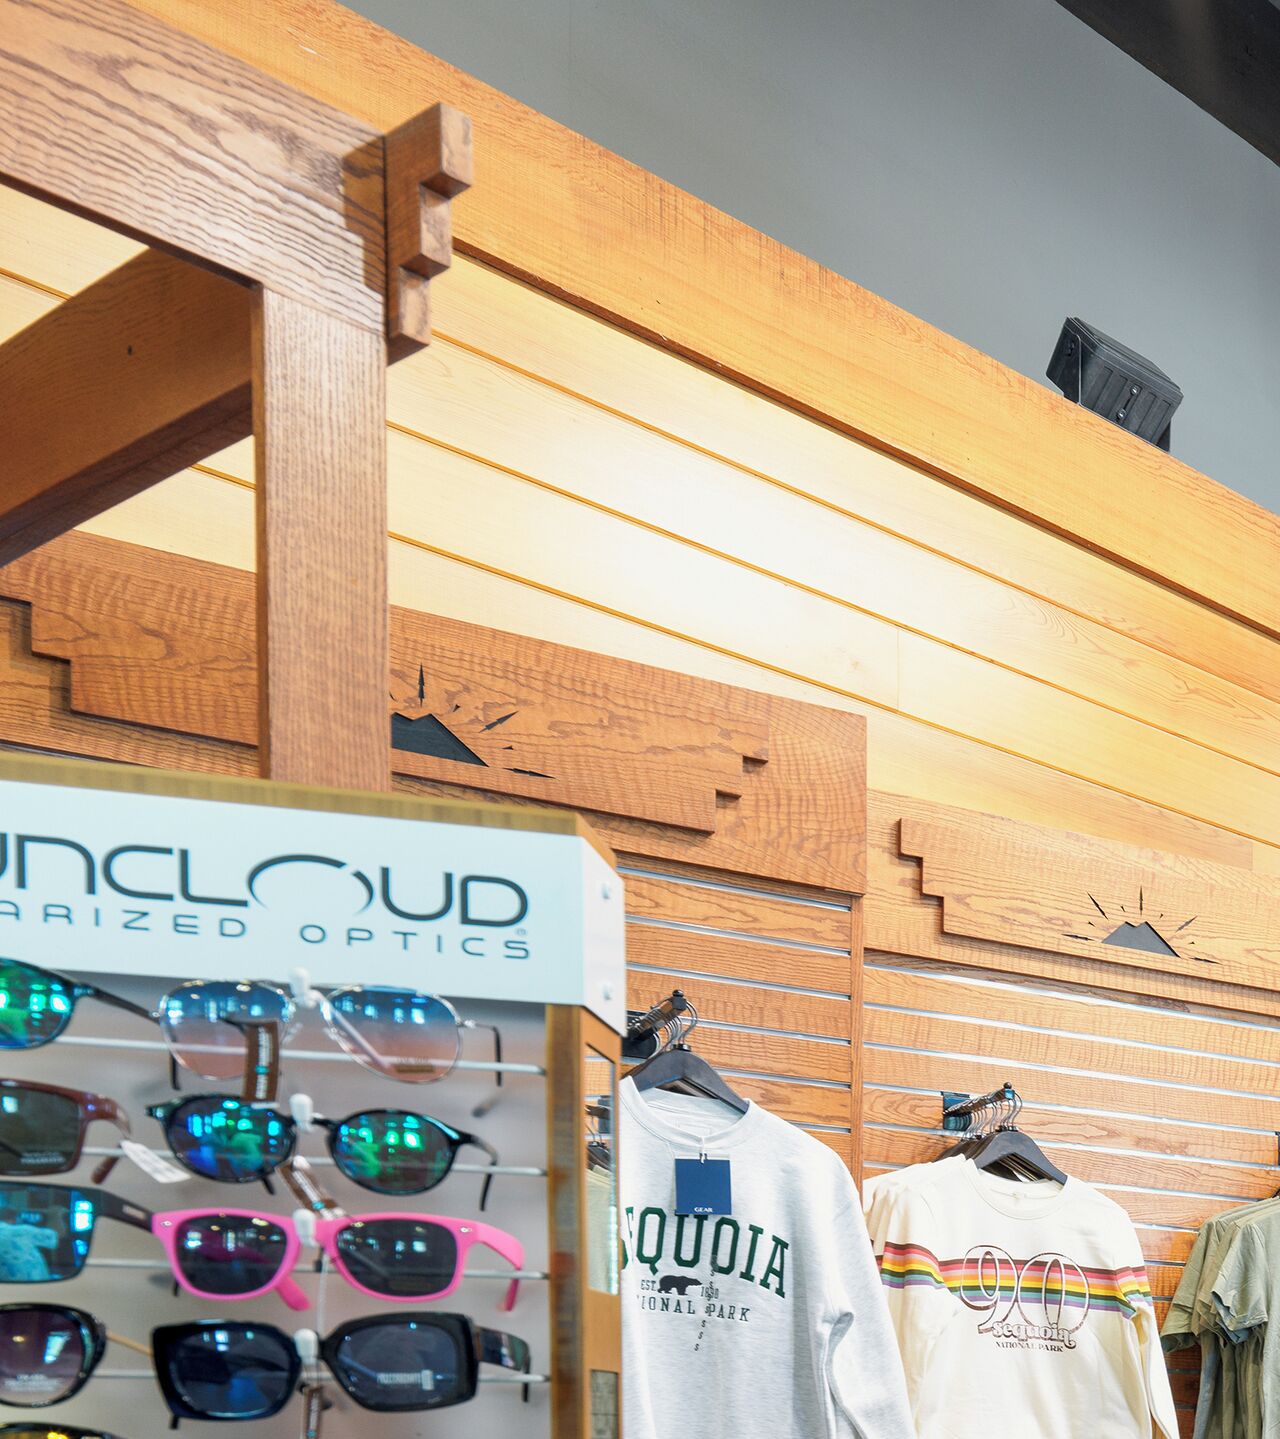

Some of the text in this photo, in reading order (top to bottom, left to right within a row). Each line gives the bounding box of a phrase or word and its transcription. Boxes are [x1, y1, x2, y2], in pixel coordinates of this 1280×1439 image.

[0, 832, 528, 928] NCLOUD
[300, 925, 529, 960] OPTICS
[960, 1244, 1090, 1335] 90
[1039, 1342, 1064, 1354] PARK
